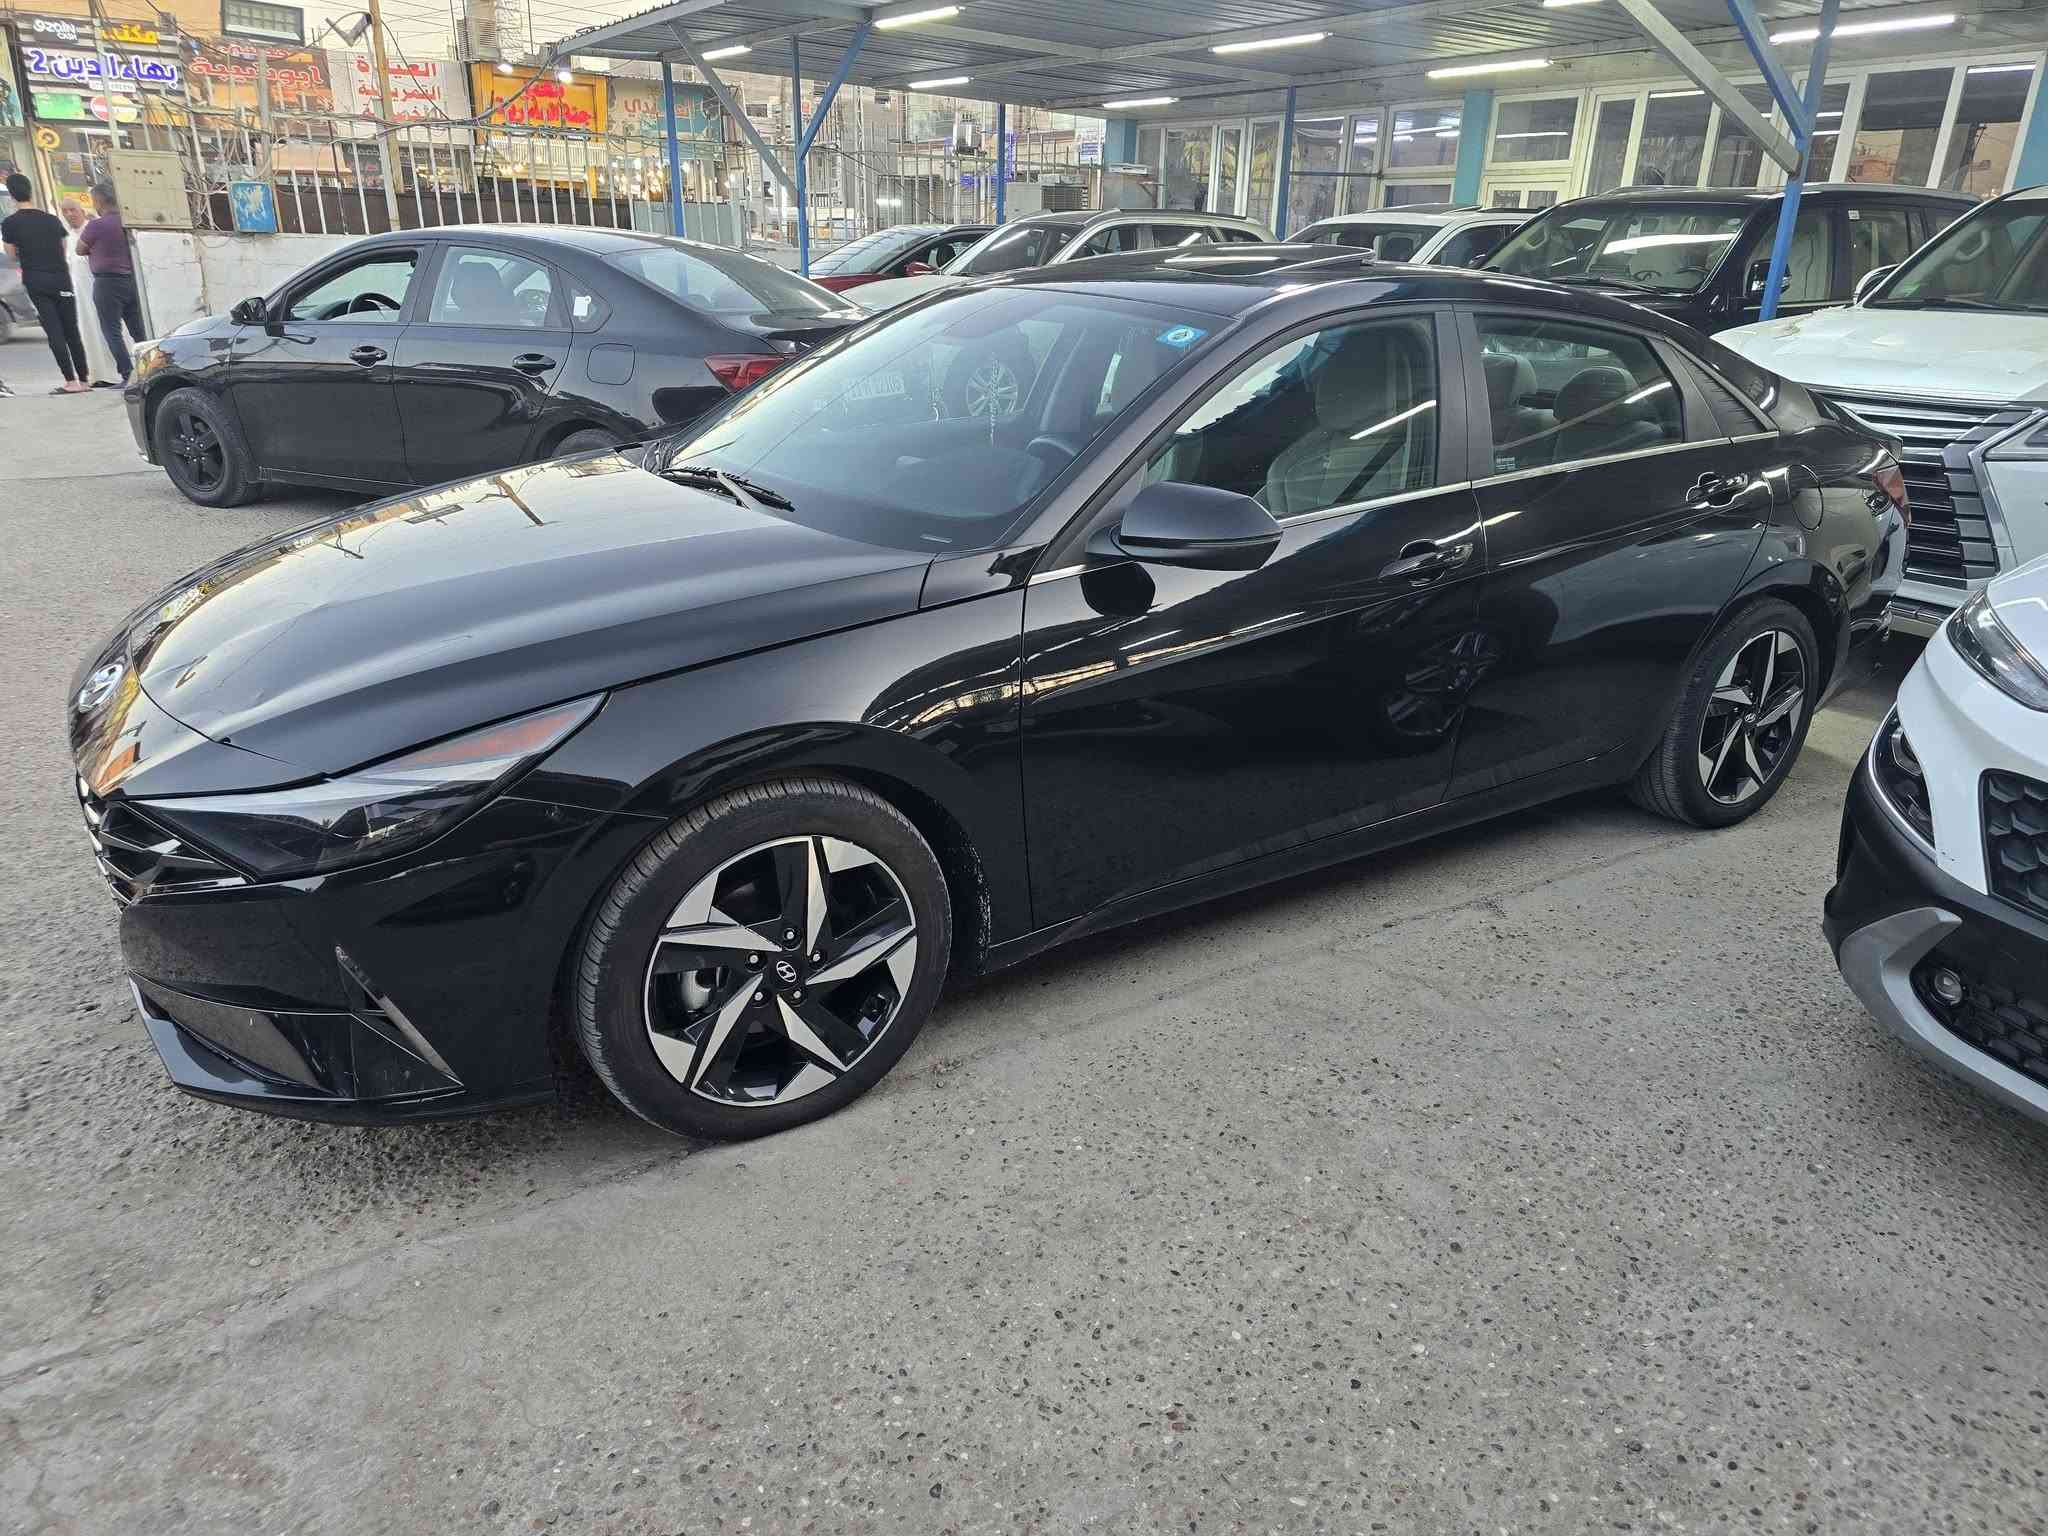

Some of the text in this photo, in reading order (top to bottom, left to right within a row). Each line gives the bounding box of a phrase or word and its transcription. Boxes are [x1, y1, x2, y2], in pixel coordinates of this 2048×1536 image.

[28, 48, 178, 89] بهاء ادين 2
[356, 55, 437, 79] العية
